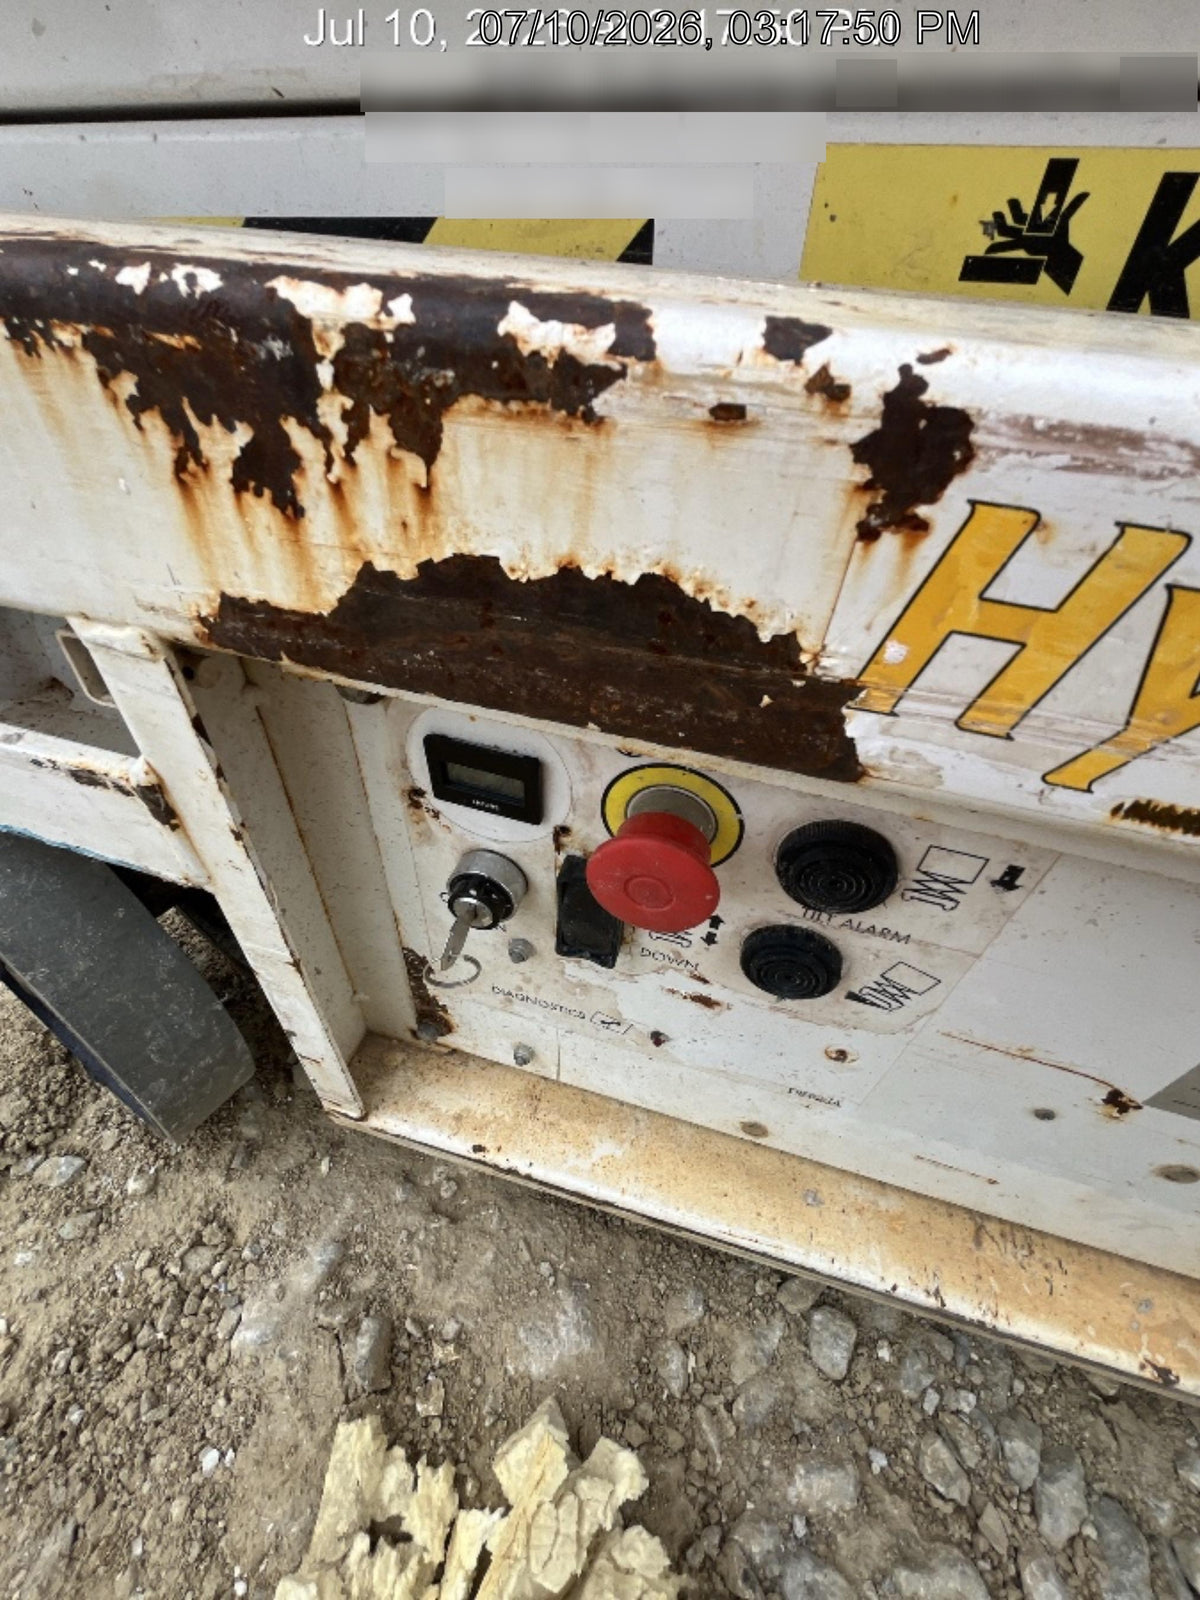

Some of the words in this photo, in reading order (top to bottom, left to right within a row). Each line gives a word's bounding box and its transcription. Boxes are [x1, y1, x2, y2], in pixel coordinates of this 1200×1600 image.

[840, 918, 912, 945] ALARM
[640, 946, 701, 972] DOWN
[491, 984, 586, 1020] DIAGNOSTICS
